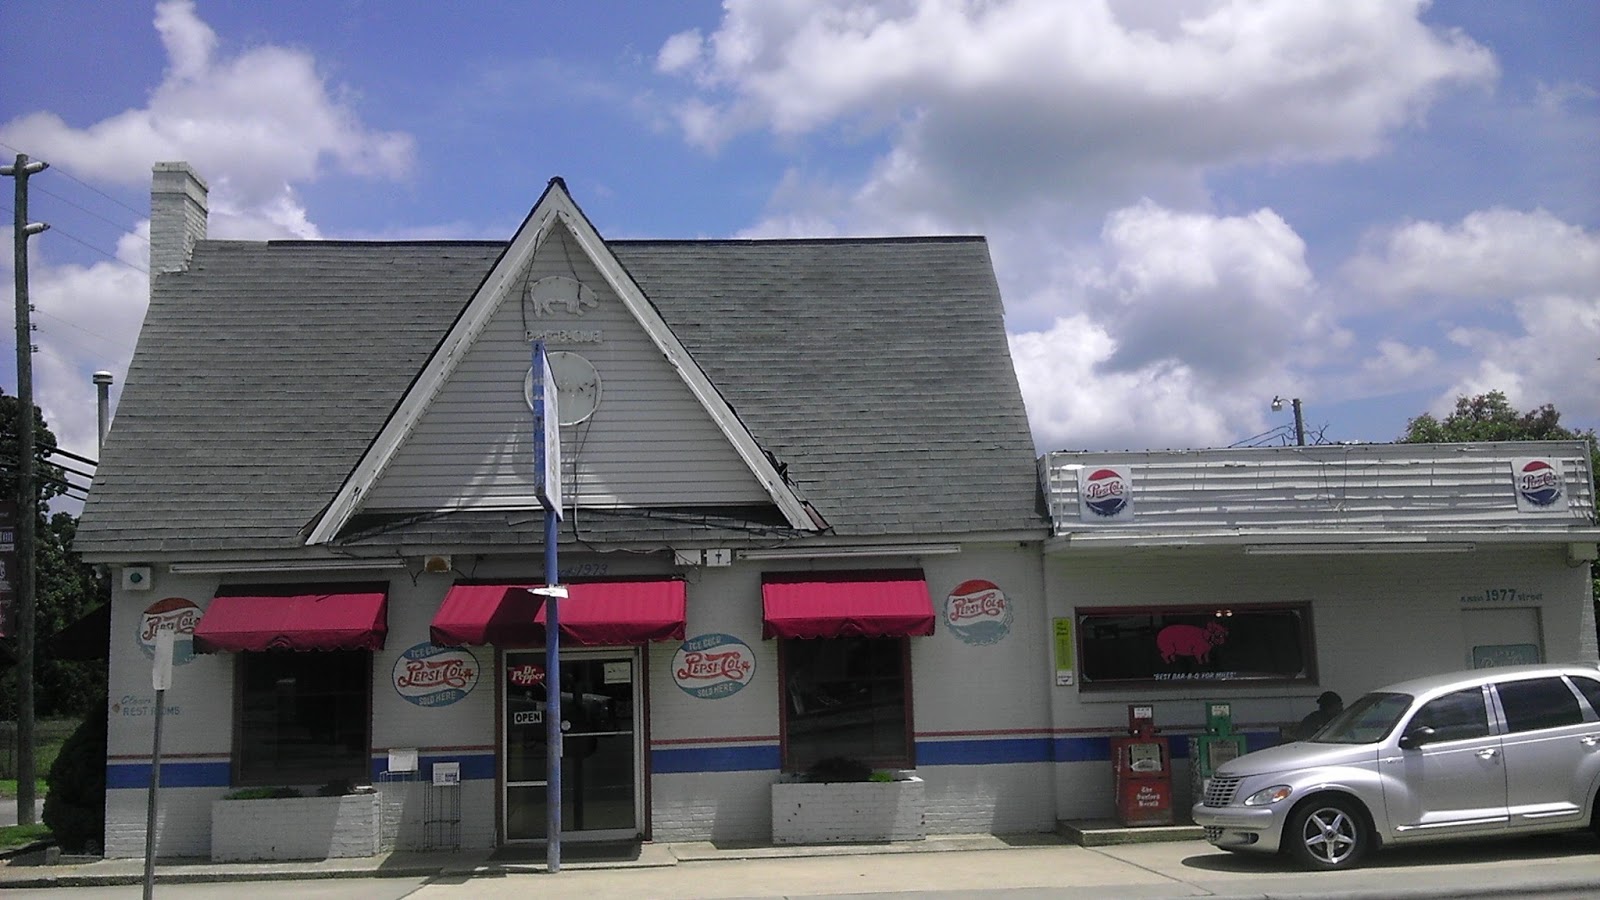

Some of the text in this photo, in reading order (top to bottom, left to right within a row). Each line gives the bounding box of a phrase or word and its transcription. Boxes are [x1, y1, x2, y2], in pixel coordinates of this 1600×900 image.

[1485, 588, 1516, 602] 1977
[511, 670, 546, 684] Pepper
[522, 666, 537, 676] Dr
[697, 682, 733, 698] SOLD HERE
[418, 691, 457, 706] SOLD HERE
[515, 712, 541, 723] OPEN
